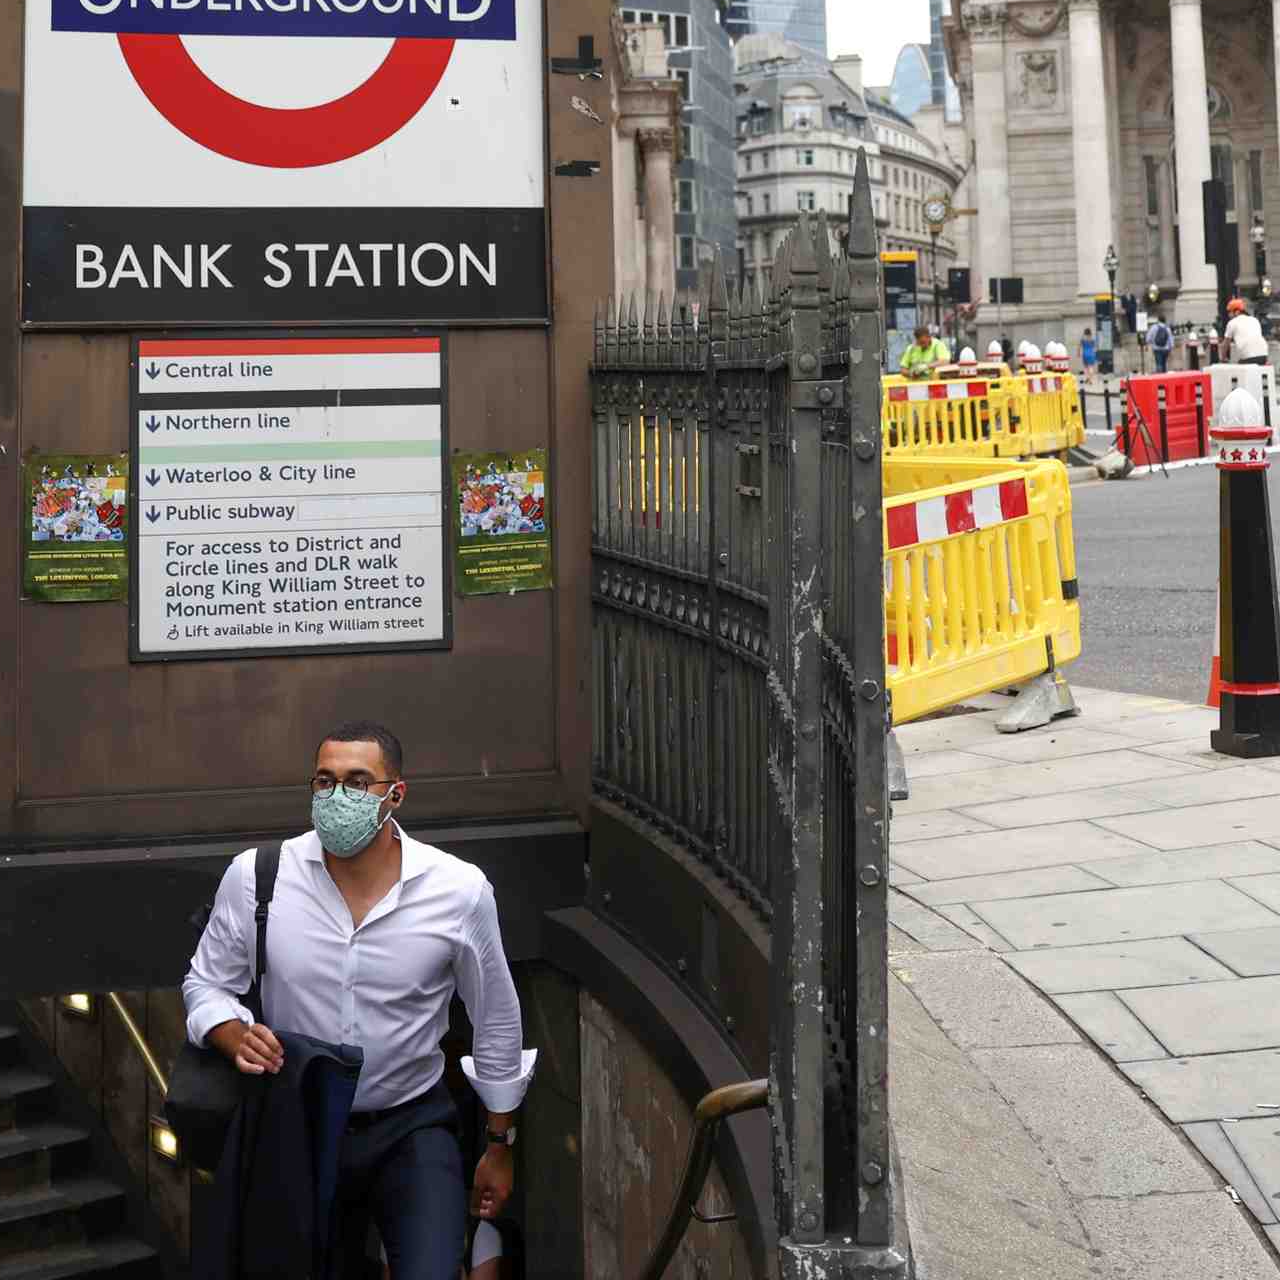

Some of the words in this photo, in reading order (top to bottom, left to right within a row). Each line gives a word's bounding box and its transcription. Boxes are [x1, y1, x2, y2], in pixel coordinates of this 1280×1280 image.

[76, 244, 233, 289] BANK
[263, 242, 497, 288] STATION
[165, 362, 234, 378] Central
[240, 361, 273, 377] line
[166, 414, 251, 431] Northern
[258, 413, 290, 429] line
[165, 467, 252, 484] Waterloo
[259, 465, 272, 482] &
[279, 465, 317, 484] City
[323, 464, 356, 480] line
[166, 504, 222, 521] Public
[227, 503, 296, 522] subway
[166, 541, 195, 557] For
[200, 541, 262, 556] access
[268, 539, 289, 553] to
[296, 535, 364, 553] District
[369, 533, 401, 550] and
[165, 559, 219, 577] Circle
[225, 559, 269, 575] lines
[275, 556, 308, 573] and
[315, 555, 351, 572] DLR
[357, 553, 398, 570] walk
[165, 581, 215, 600] along
[222, 579, 262, 598] King
[268, 576, 337, 593] William
[343, 575, 400, 591] Street
[405, 574, 425, 589] to
[166, 599, 267, 618] Monument
[272, 596, 338, 614] station
[344, 596, 423, 611] entrance
[185, 624, 209, 638] Lift
[214, 623, 273, 637] available
[278, 621, 290, 633] in
[295, 621, 324, 635] King
[328, 618, 380, 631] William
[383, 617, 425, 629] street
